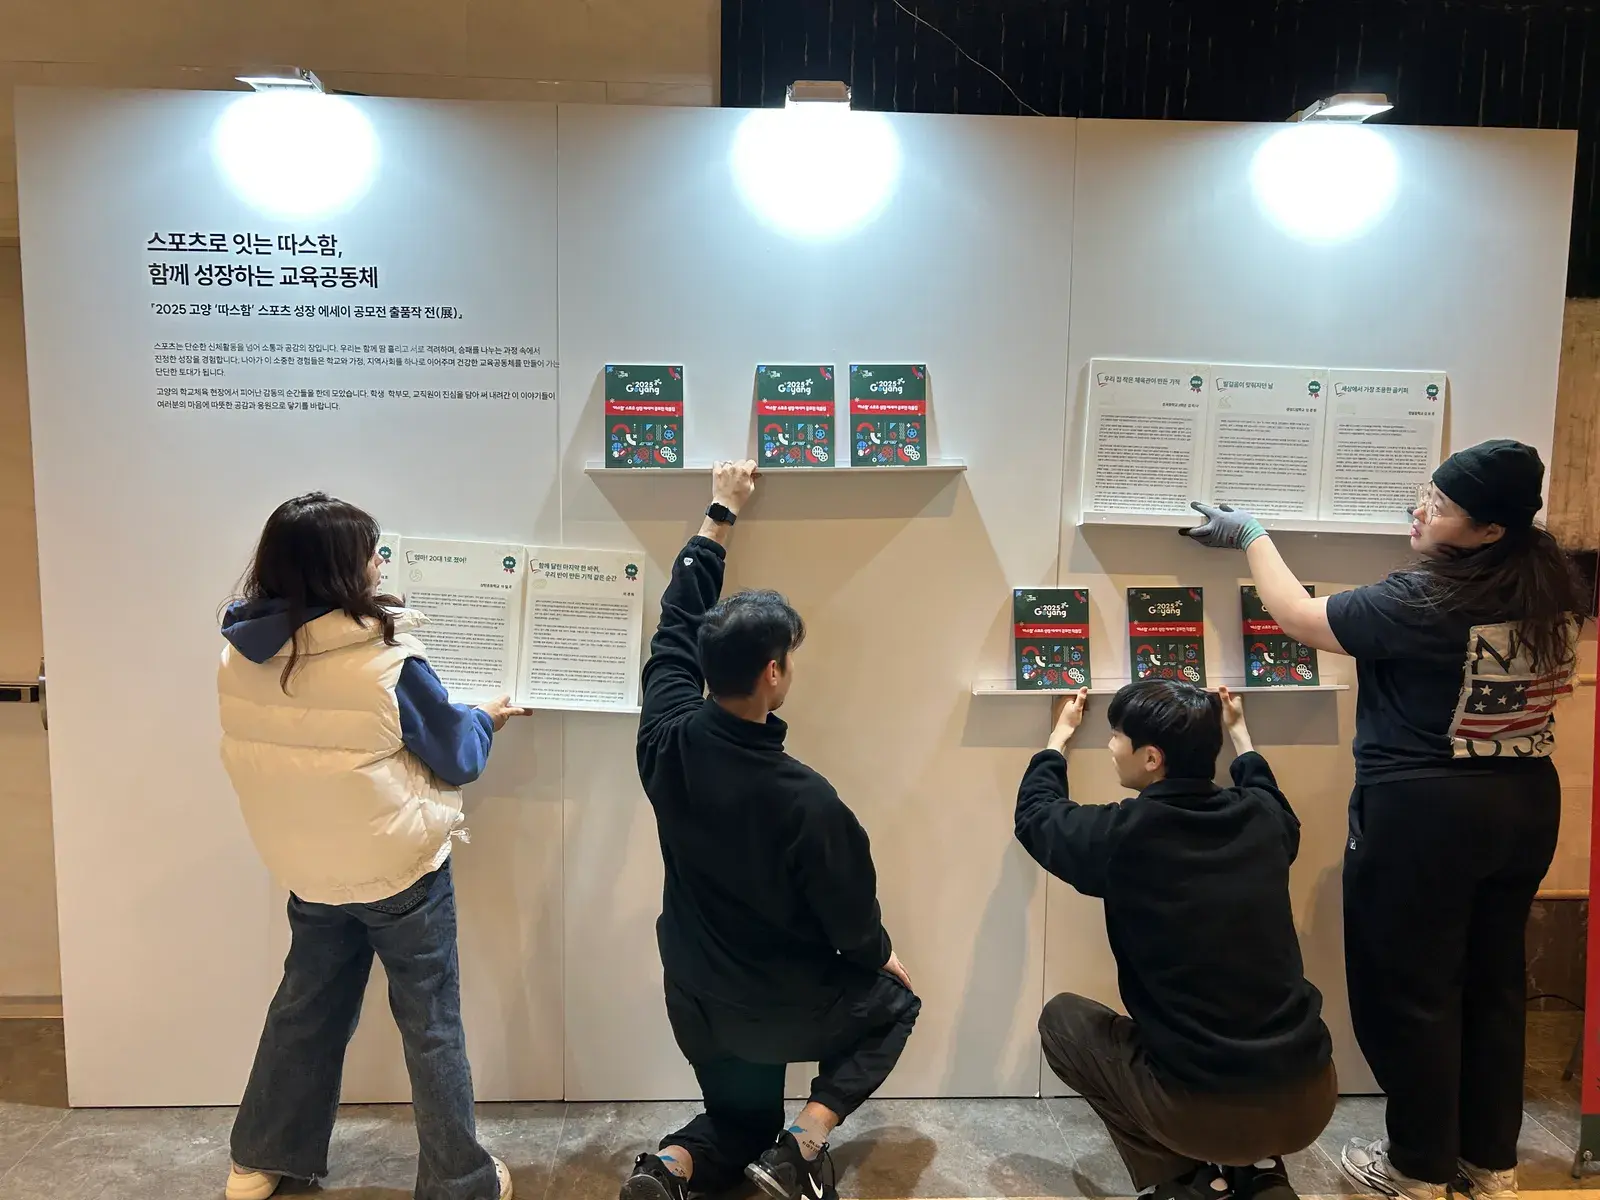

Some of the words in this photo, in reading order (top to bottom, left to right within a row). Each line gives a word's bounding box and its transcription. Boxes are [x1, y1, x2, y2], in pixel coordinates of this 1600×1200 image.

[147, 232, 229, 252] 스포츠로
[233, 233, 273, 255] 잇는
[278, 234, 342, 258] 따스함,
[148, 263, 189, 286] 함께
[194, 264, 275, 287] 성장하는
[279, 266, 378, 288] 교육공동체
[189, 303, 212, 316] 고양
[258, 305, 292, 316] 스포츠
[294, 305, 316, 317] 성장
[318, 305, 351, 318] 에세이
[354, 306, 386, 318] 공모전
[389, 306, 422, 319] 출품작
[154, 343, 183, 351] 스포츠는
[184, 342, 207, 351] 단순한
[208, 343, 244, 352] 신체활동을
[246, 344, 260, 352] 넘어
[262, 343, 284, 352] 소통과
[285, 344, 306, 353] 공감의
[308, 344, 338, 352] 장입니다.
[340, 345, 361, 353] 우리는
[363, 345, 377, 353] 함께
[378, 345, 386, 353] 땀
[388, 345, 409, 353] 흘리고
[410, 345, 425, 354] 서로
[458, 346, 479, 354] 승패를
[480, 346, 502, 355] 나누는
[504, 347, 518, 355] 과정
[519, 347, 540, 355] 속에서
[155, 368, 178, 376] 단단한
[179, 368, 201, 376] 토대가
[202, 368, 226, 377] 됩니다.
